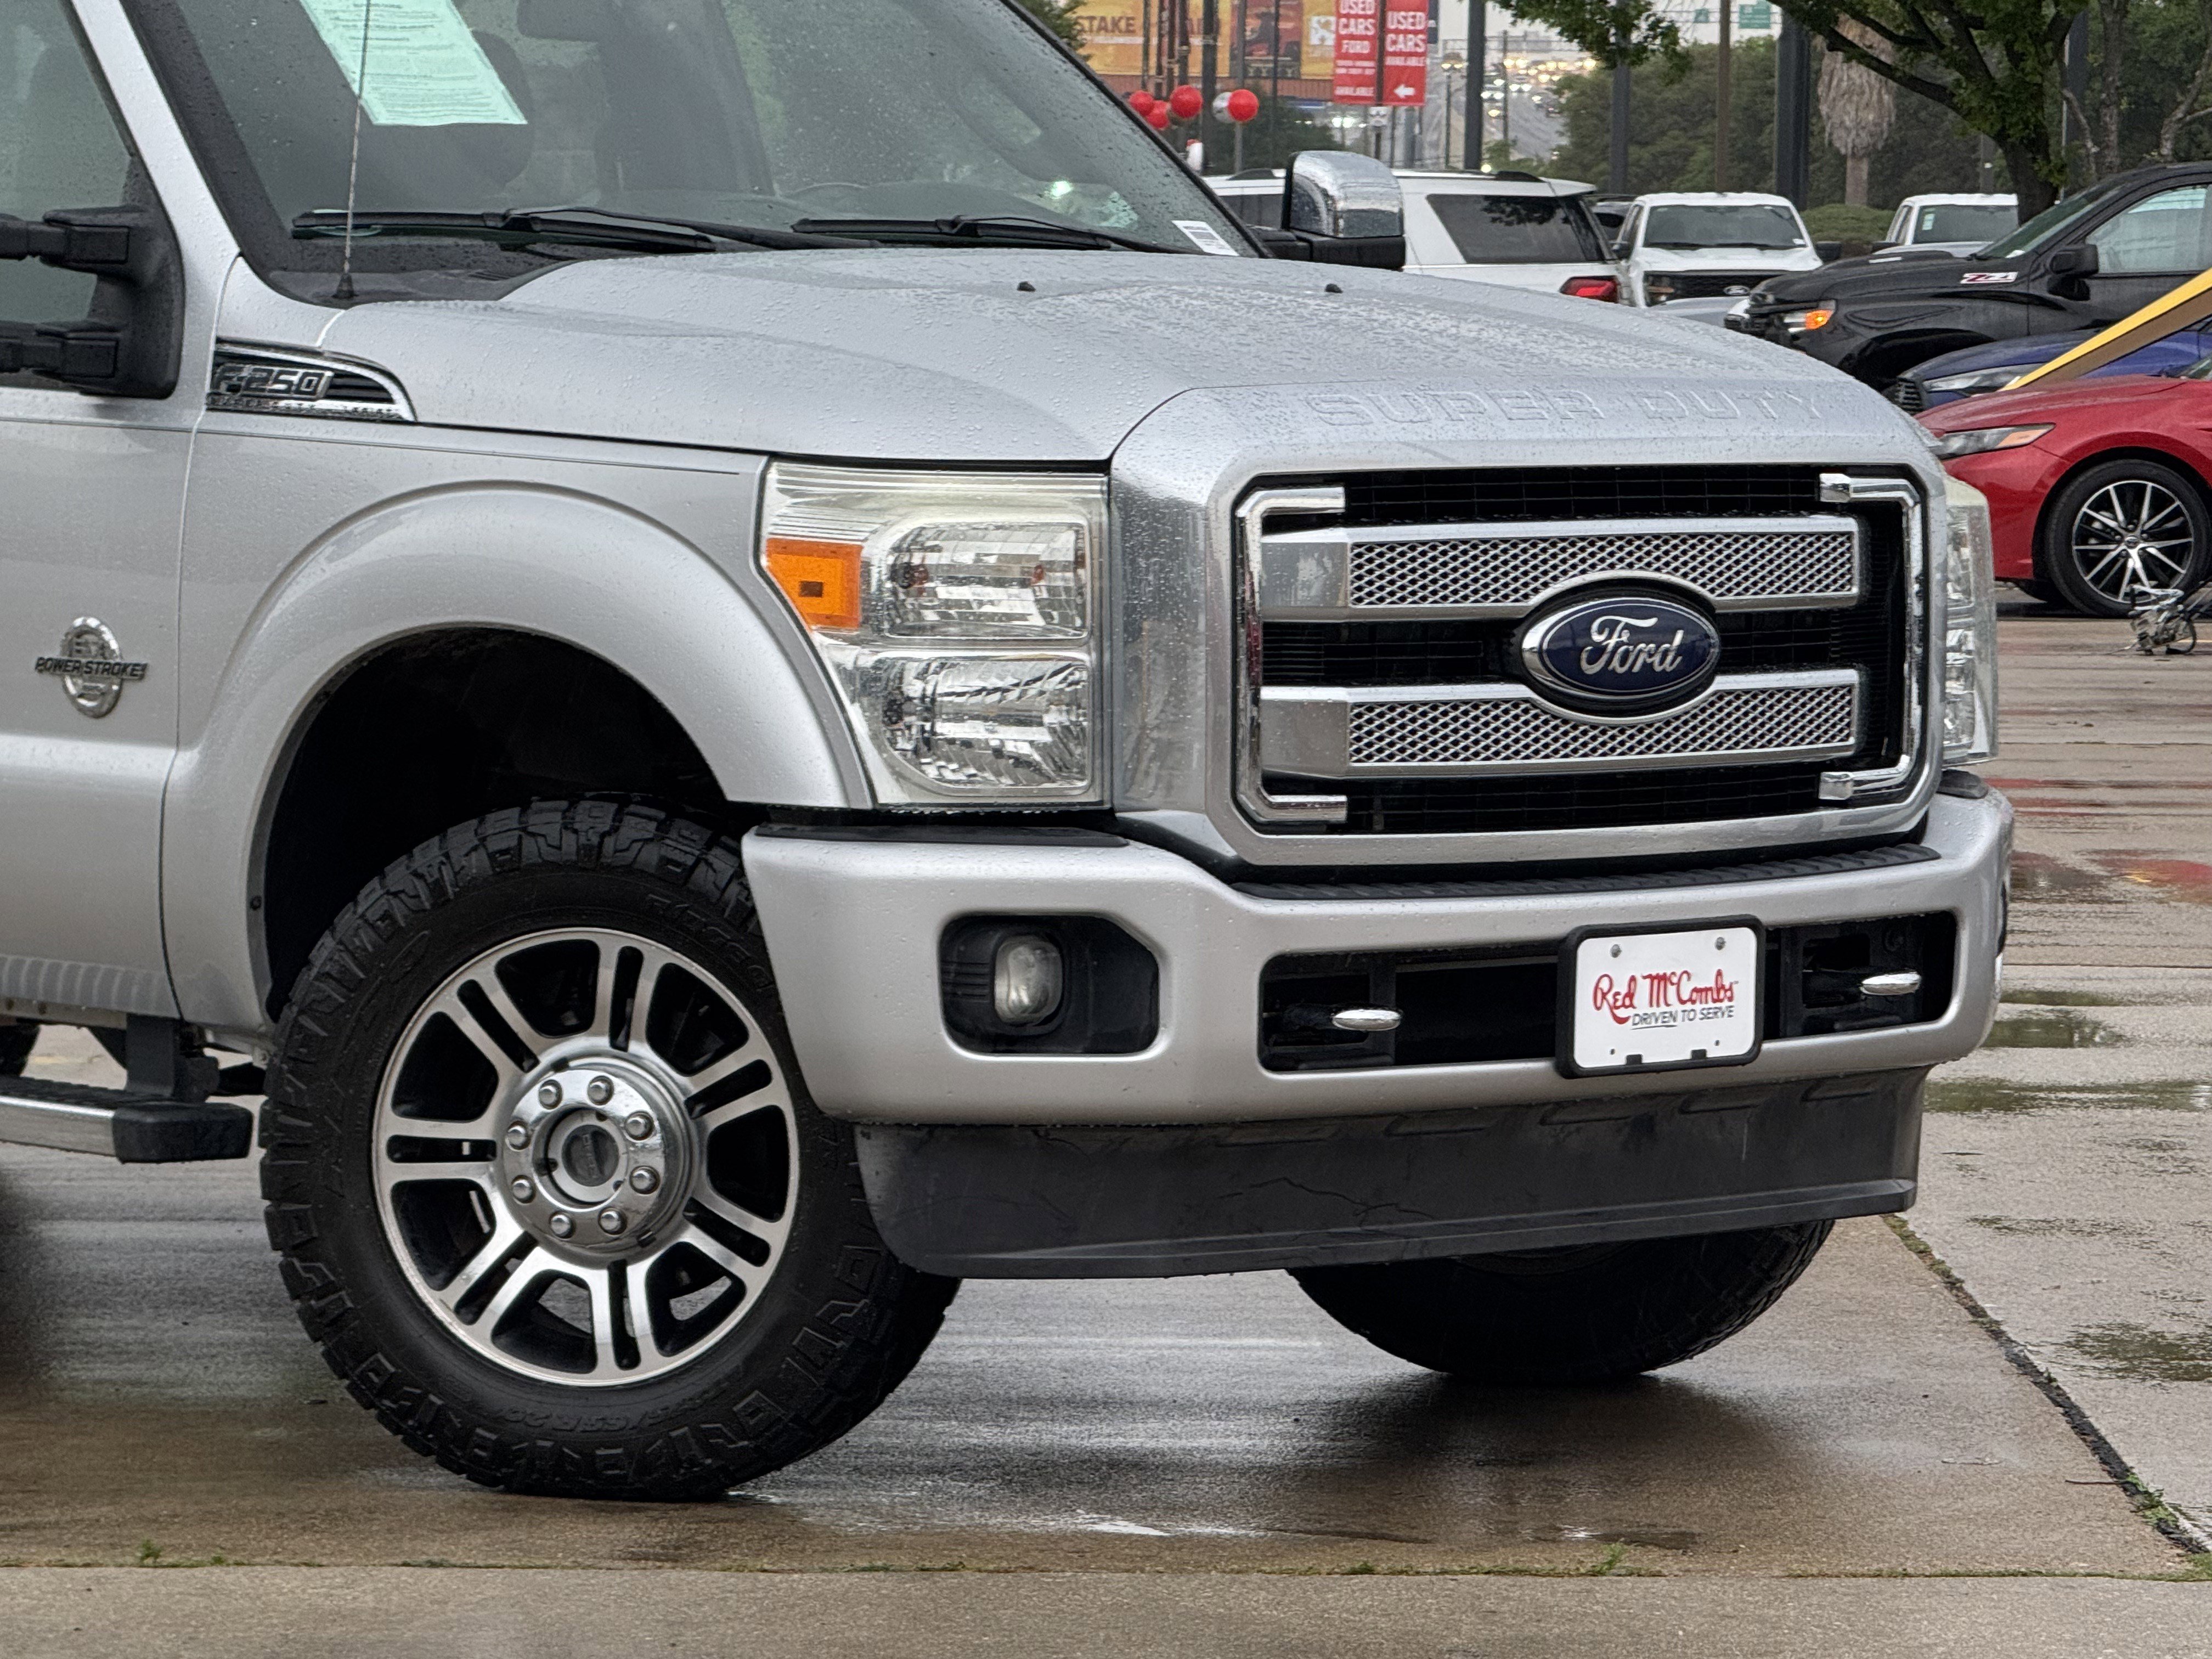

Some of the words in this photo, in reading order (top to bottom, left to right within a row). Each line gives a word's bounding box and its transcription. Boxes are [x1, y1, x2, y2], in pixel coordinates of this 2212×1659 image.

[1339, 18, 1375, 35] CARS
[1386, 11, 1426, 30] USED
[1342, 40, 1370, 53] FORD
[1386, 33, 1426, 52] CARS
[1305, 390, 1605, 426] SUPER
[1632, 390, 1821, 420] DUTY
[1580, 615, 1685, 675] Ford
[1593, 973, 1637, 1025] Red
[1631, 1011, 1678, 1026] DRIVEN
[1681, 1008, 1697, 1023] TO
[1699, 1005, 1735, 1021] SERVE
